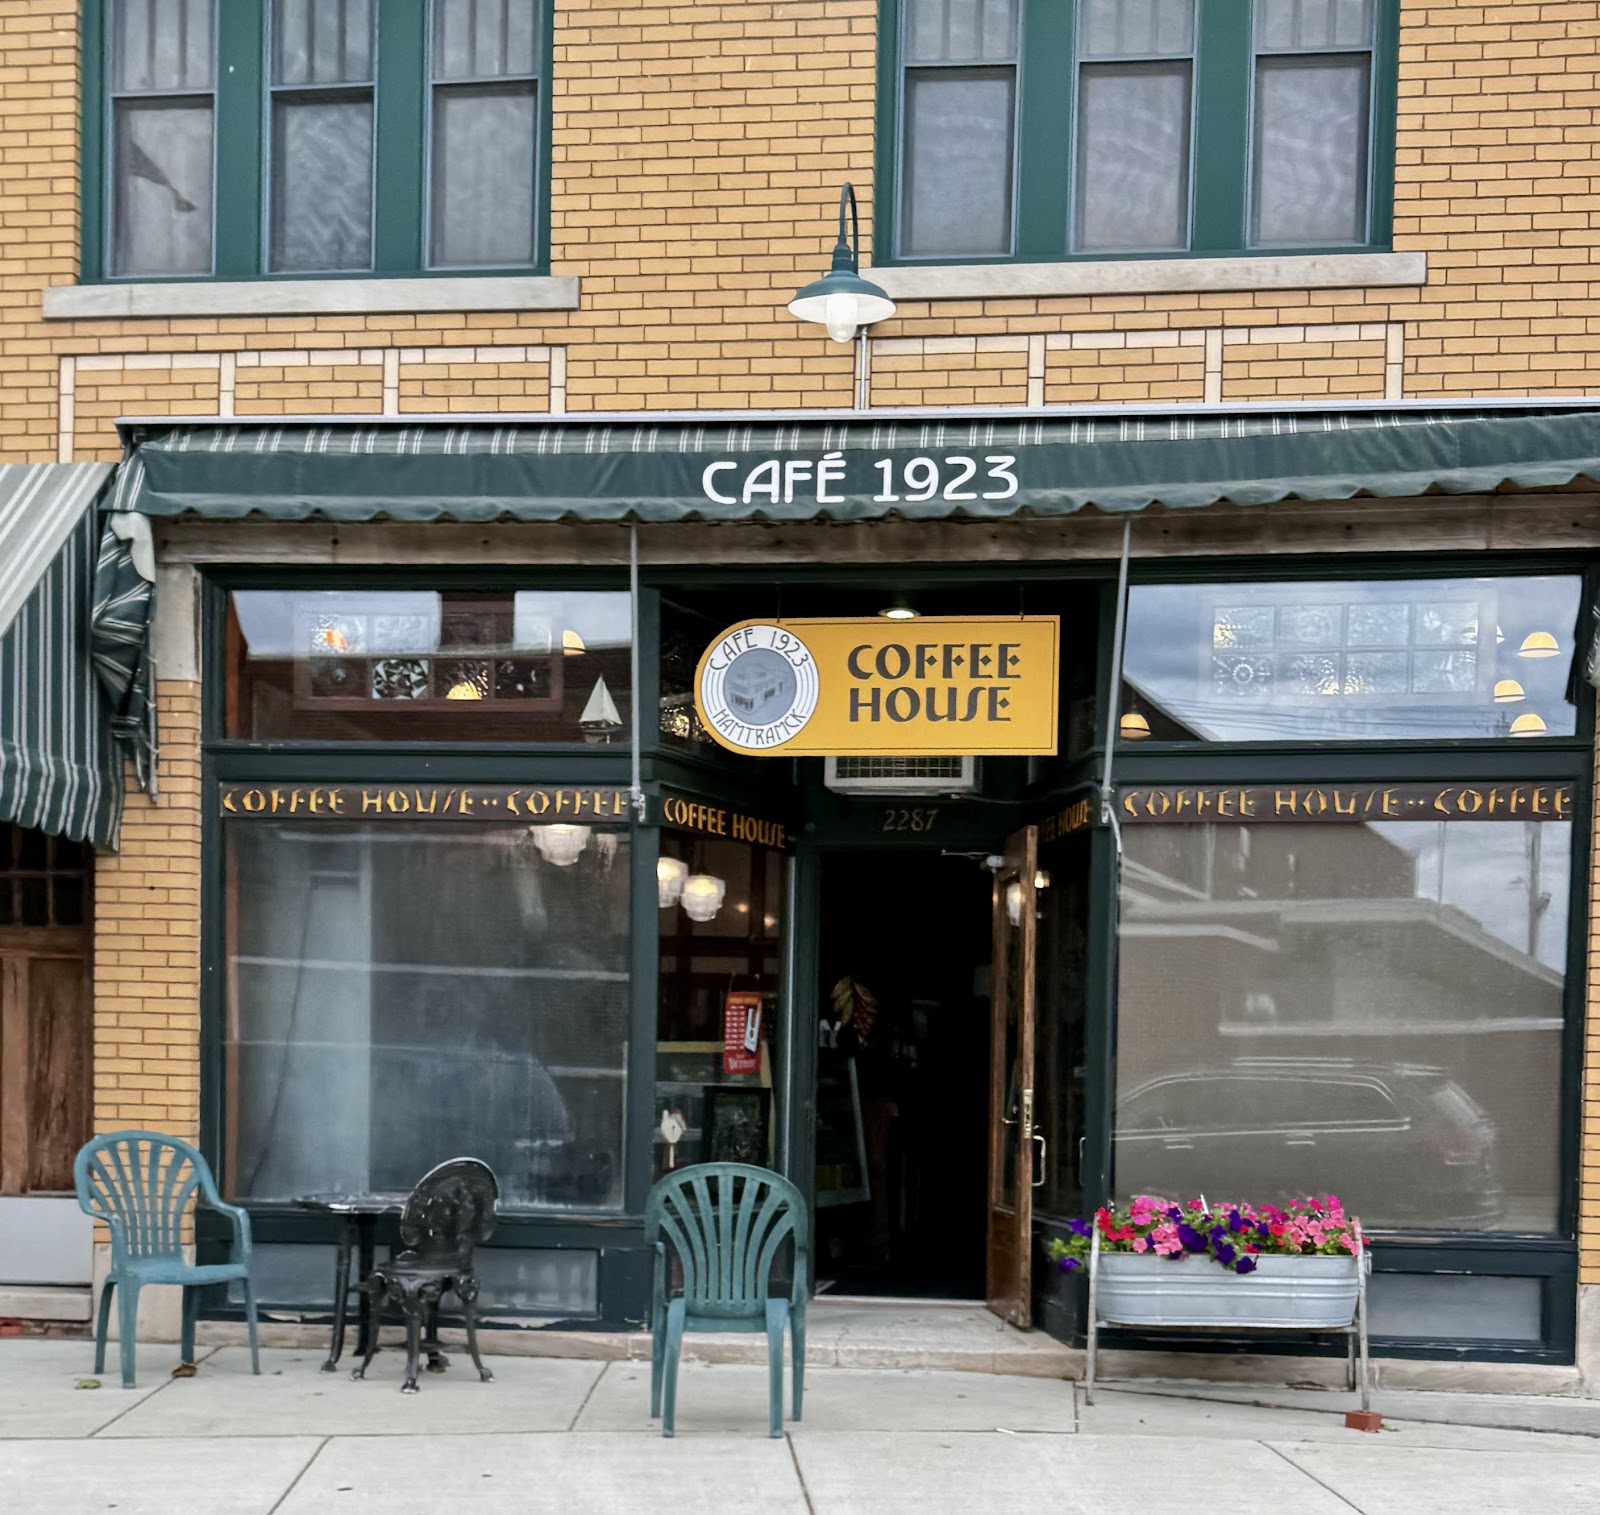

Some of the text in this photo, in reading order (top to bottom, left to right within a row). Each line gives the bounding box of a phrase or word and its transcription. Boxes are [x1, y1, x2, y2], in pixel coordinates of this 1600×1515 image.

[702, 451, 1019, 504] CAFÉ 1923
[709, 628, 809, 671] CAFE 1923
[847, 643, 1021, 680] COFFEE
[848, 686, 1011, 723] HOUSE
[711, 708, 807, 745] HAMTRAMCK
[223, 788, 344, 816] COFFEE
[361, 789, 475, 816] HOUSE
[881, 808, 939, 832] 2287
[1123, 788, 1573, 818] COFFEE HOUSE COFFEE
[663, 797, 786, 849] COFFEE HOUSE
